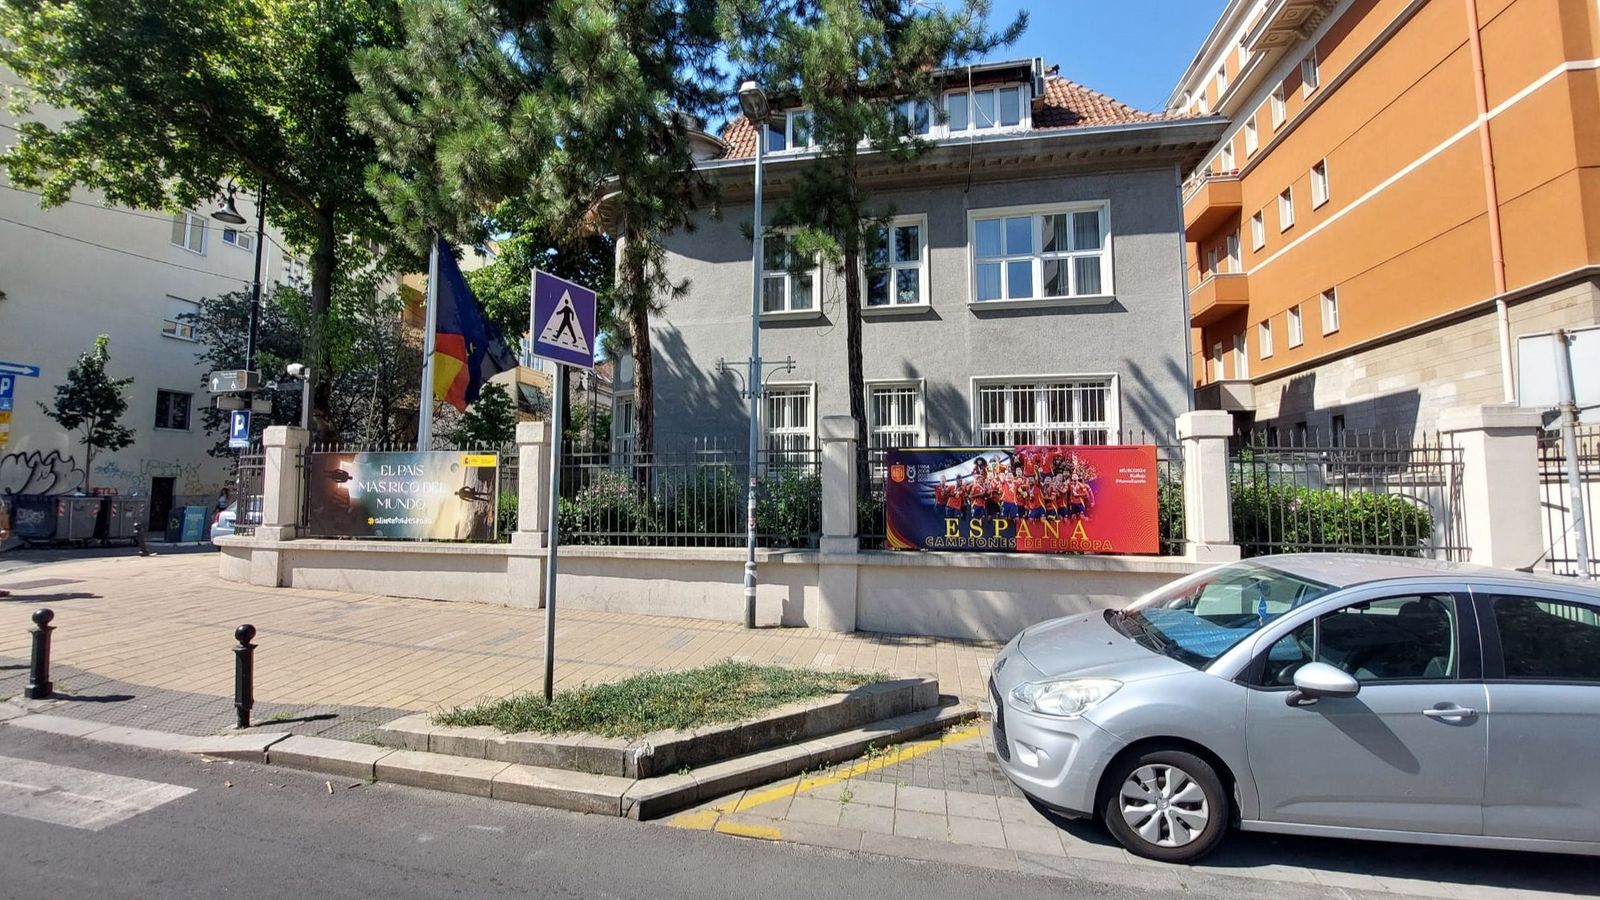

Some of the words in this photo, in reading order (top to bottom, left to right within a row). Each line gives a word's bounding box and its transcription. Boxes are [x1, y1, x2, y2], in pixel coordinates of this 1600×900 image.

[0, 377, 11, 395] P
[234, 414, 246, 436] P
[380, 464, 396, 476] EL
[397, 463, 424, 476] PAÍS
[358, 480, 387, 493] MÁS
[388, 481, 420, 493] RICO
[423, 481, 444, 493] DEL
[376, 497, 426, 510] MUNDO
[944, 515, 1089, 540] ESPAÑA
[925, 536, 1017, 548] CAMPEONES
[1024, 538, 1042, 549] DE
[1051, 538, 1113, 550] EUROPA
